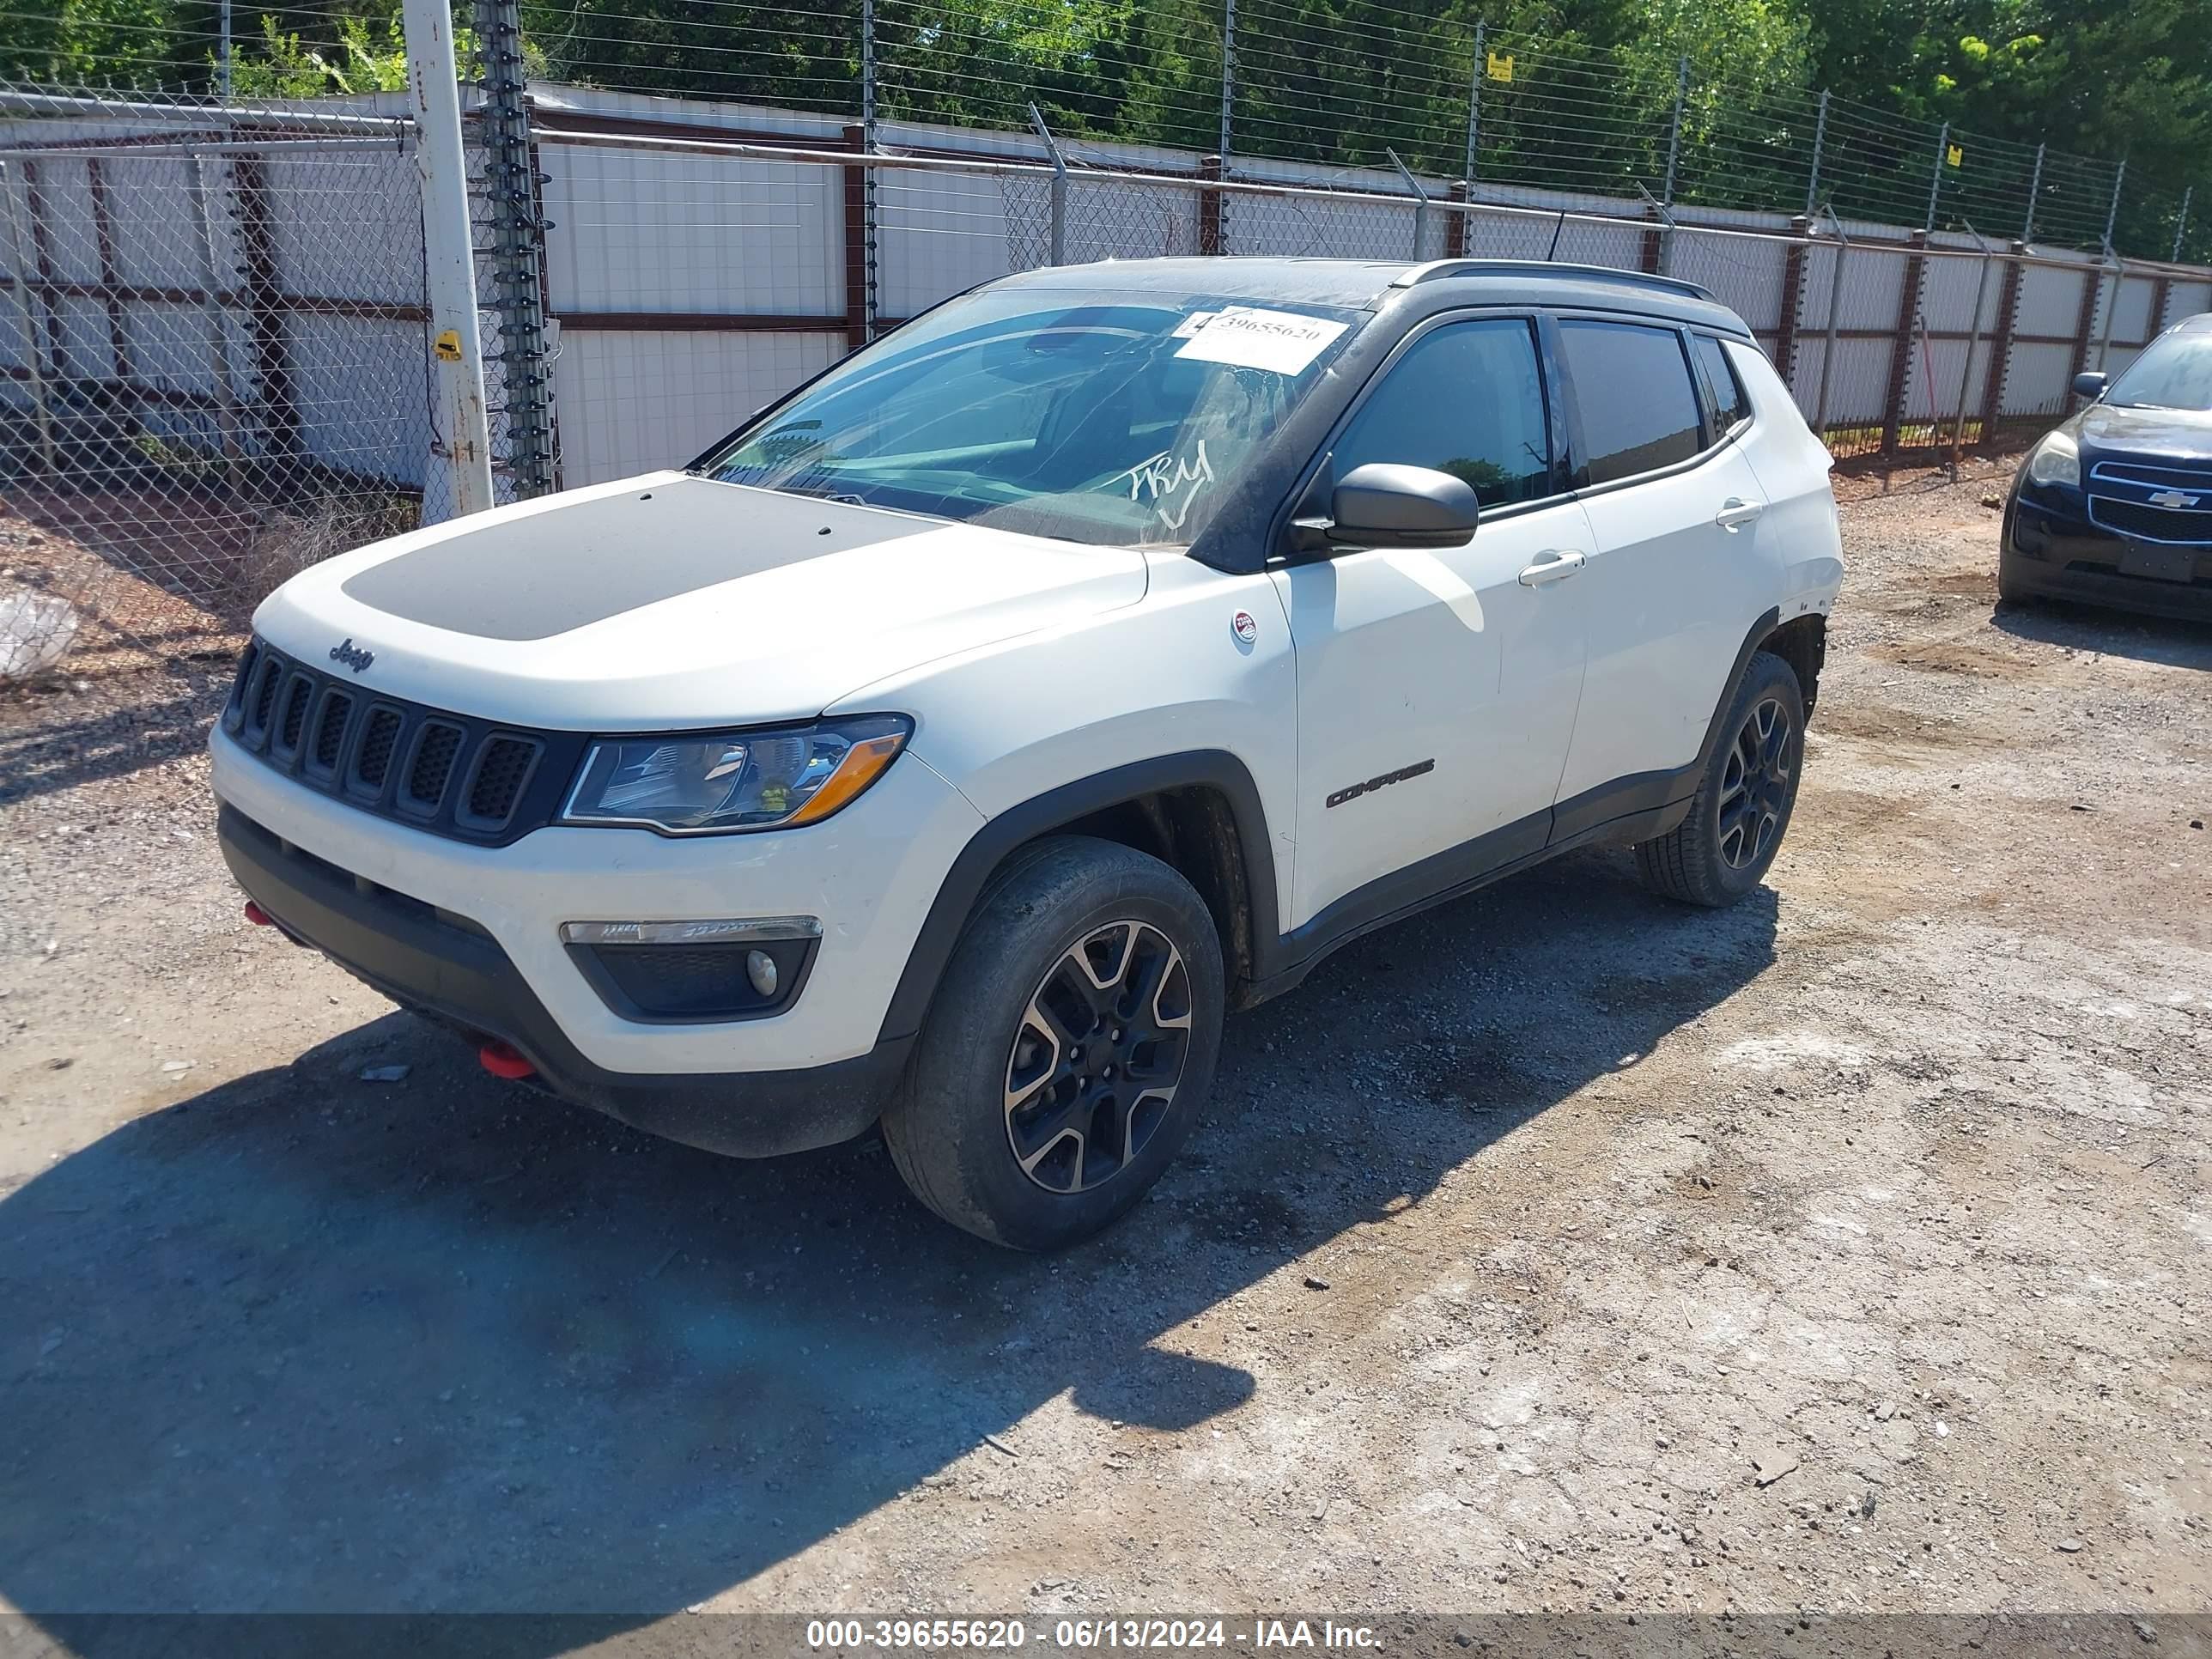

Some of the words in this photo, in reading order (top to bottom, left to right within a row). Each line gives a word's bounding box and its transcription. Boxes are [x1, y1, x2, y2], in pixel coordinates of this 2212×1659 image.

[1194, 314, 1215, 333] 4
[1219, 316, 1322, 342] 39655620
[329, 637, 375, 674] Jeep
